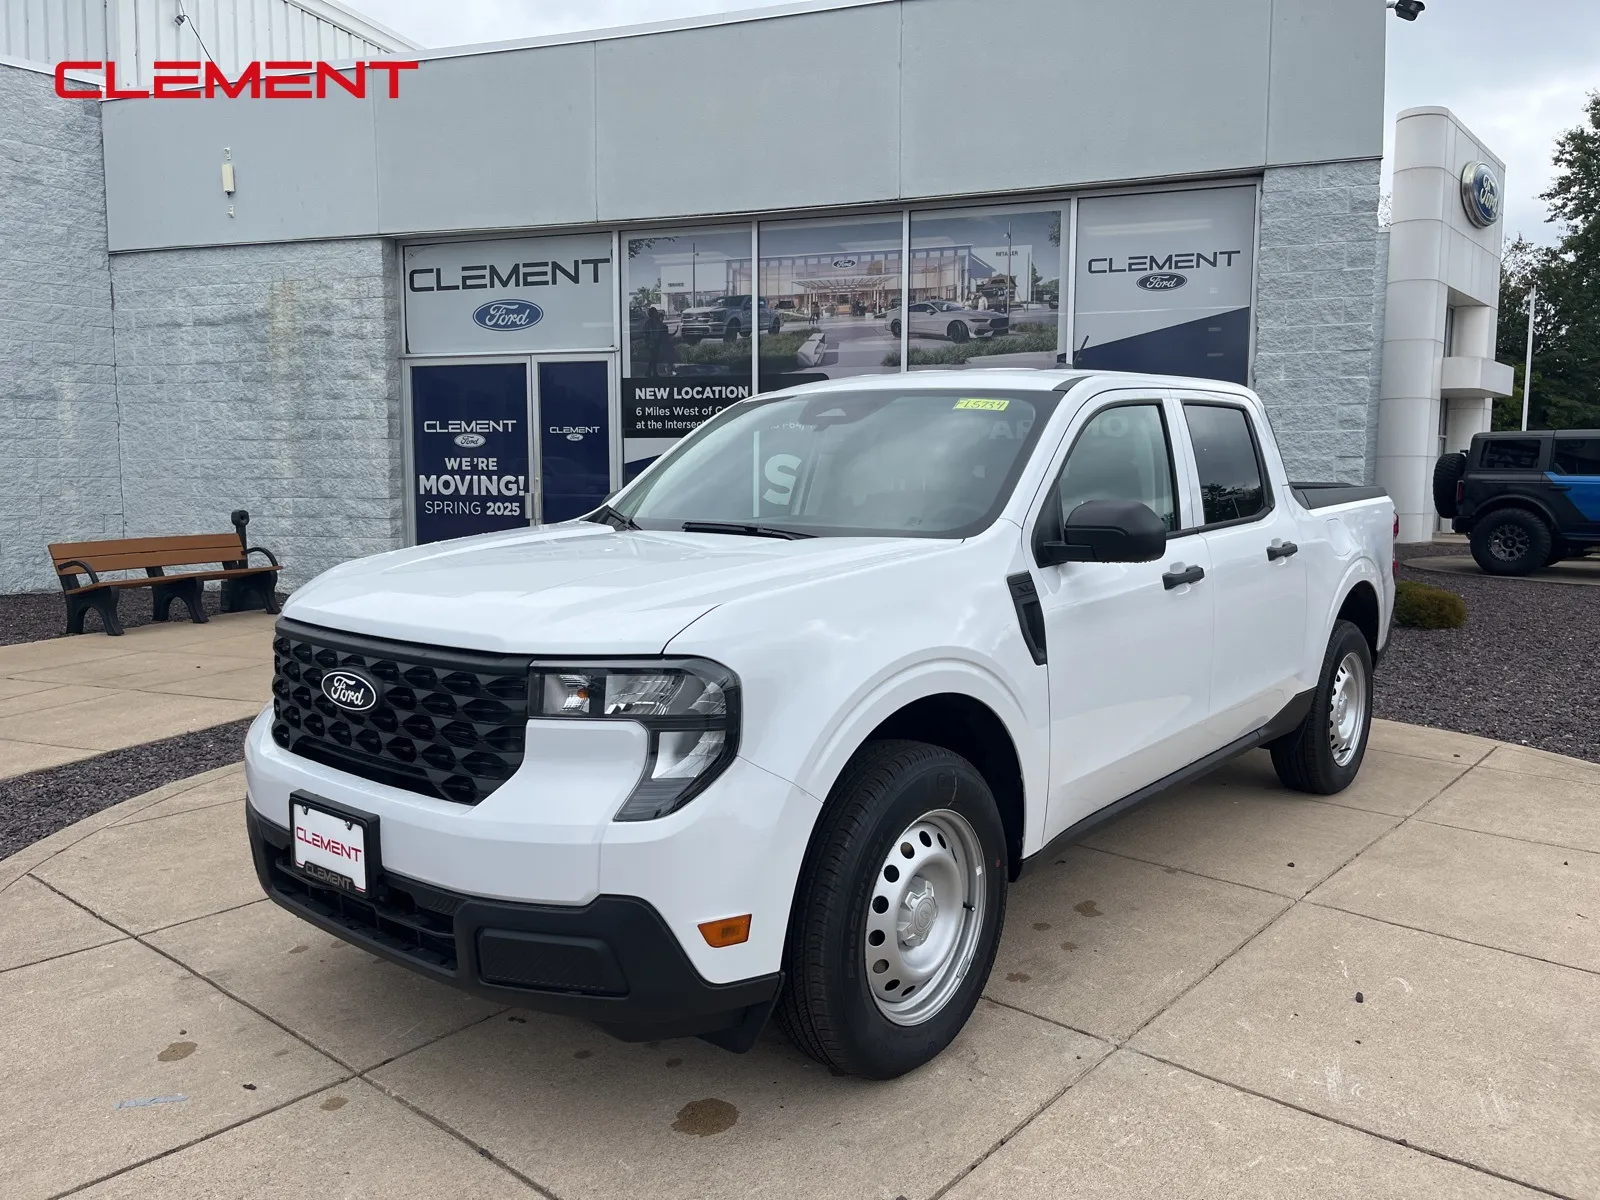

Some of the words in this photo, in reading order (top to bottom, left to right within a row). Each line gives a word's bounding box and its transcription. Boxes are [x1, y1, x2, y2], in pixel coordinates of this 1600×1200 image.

[1088, 250, 1241, 274] CLEMENT
[409, 257, 610, 292] CLEMENT
[1146, 275, 1177, 288] Ford
[485, 304, 530, 326] Ford
[635, 387, 670, 400] NEW
[673, 385, 749, 399] LOCATION
[636, 407, 642, 416] 6
[645, 407, 670, 416] Miles
[673, 406, 699, 416] West
[701, 406, 713, 415] of
[423, 420, 517, 433] CLEMENT
[549, 426, 600, 434] CLEMENT
[636, 420, 645, 429] at
[647, 420, 663, 429] the
[665, 419, 705, 429] Intersec
[419, 474, 525, 496] MOVING!
[424, 501, 481, 515] SPRING
[486, 502, 520, 516] 2025
[331, 676, 364, 705] Ford
[296, 826, 362, 862] CLEMENT
[305, 864, 352, 890] CLEMENT
